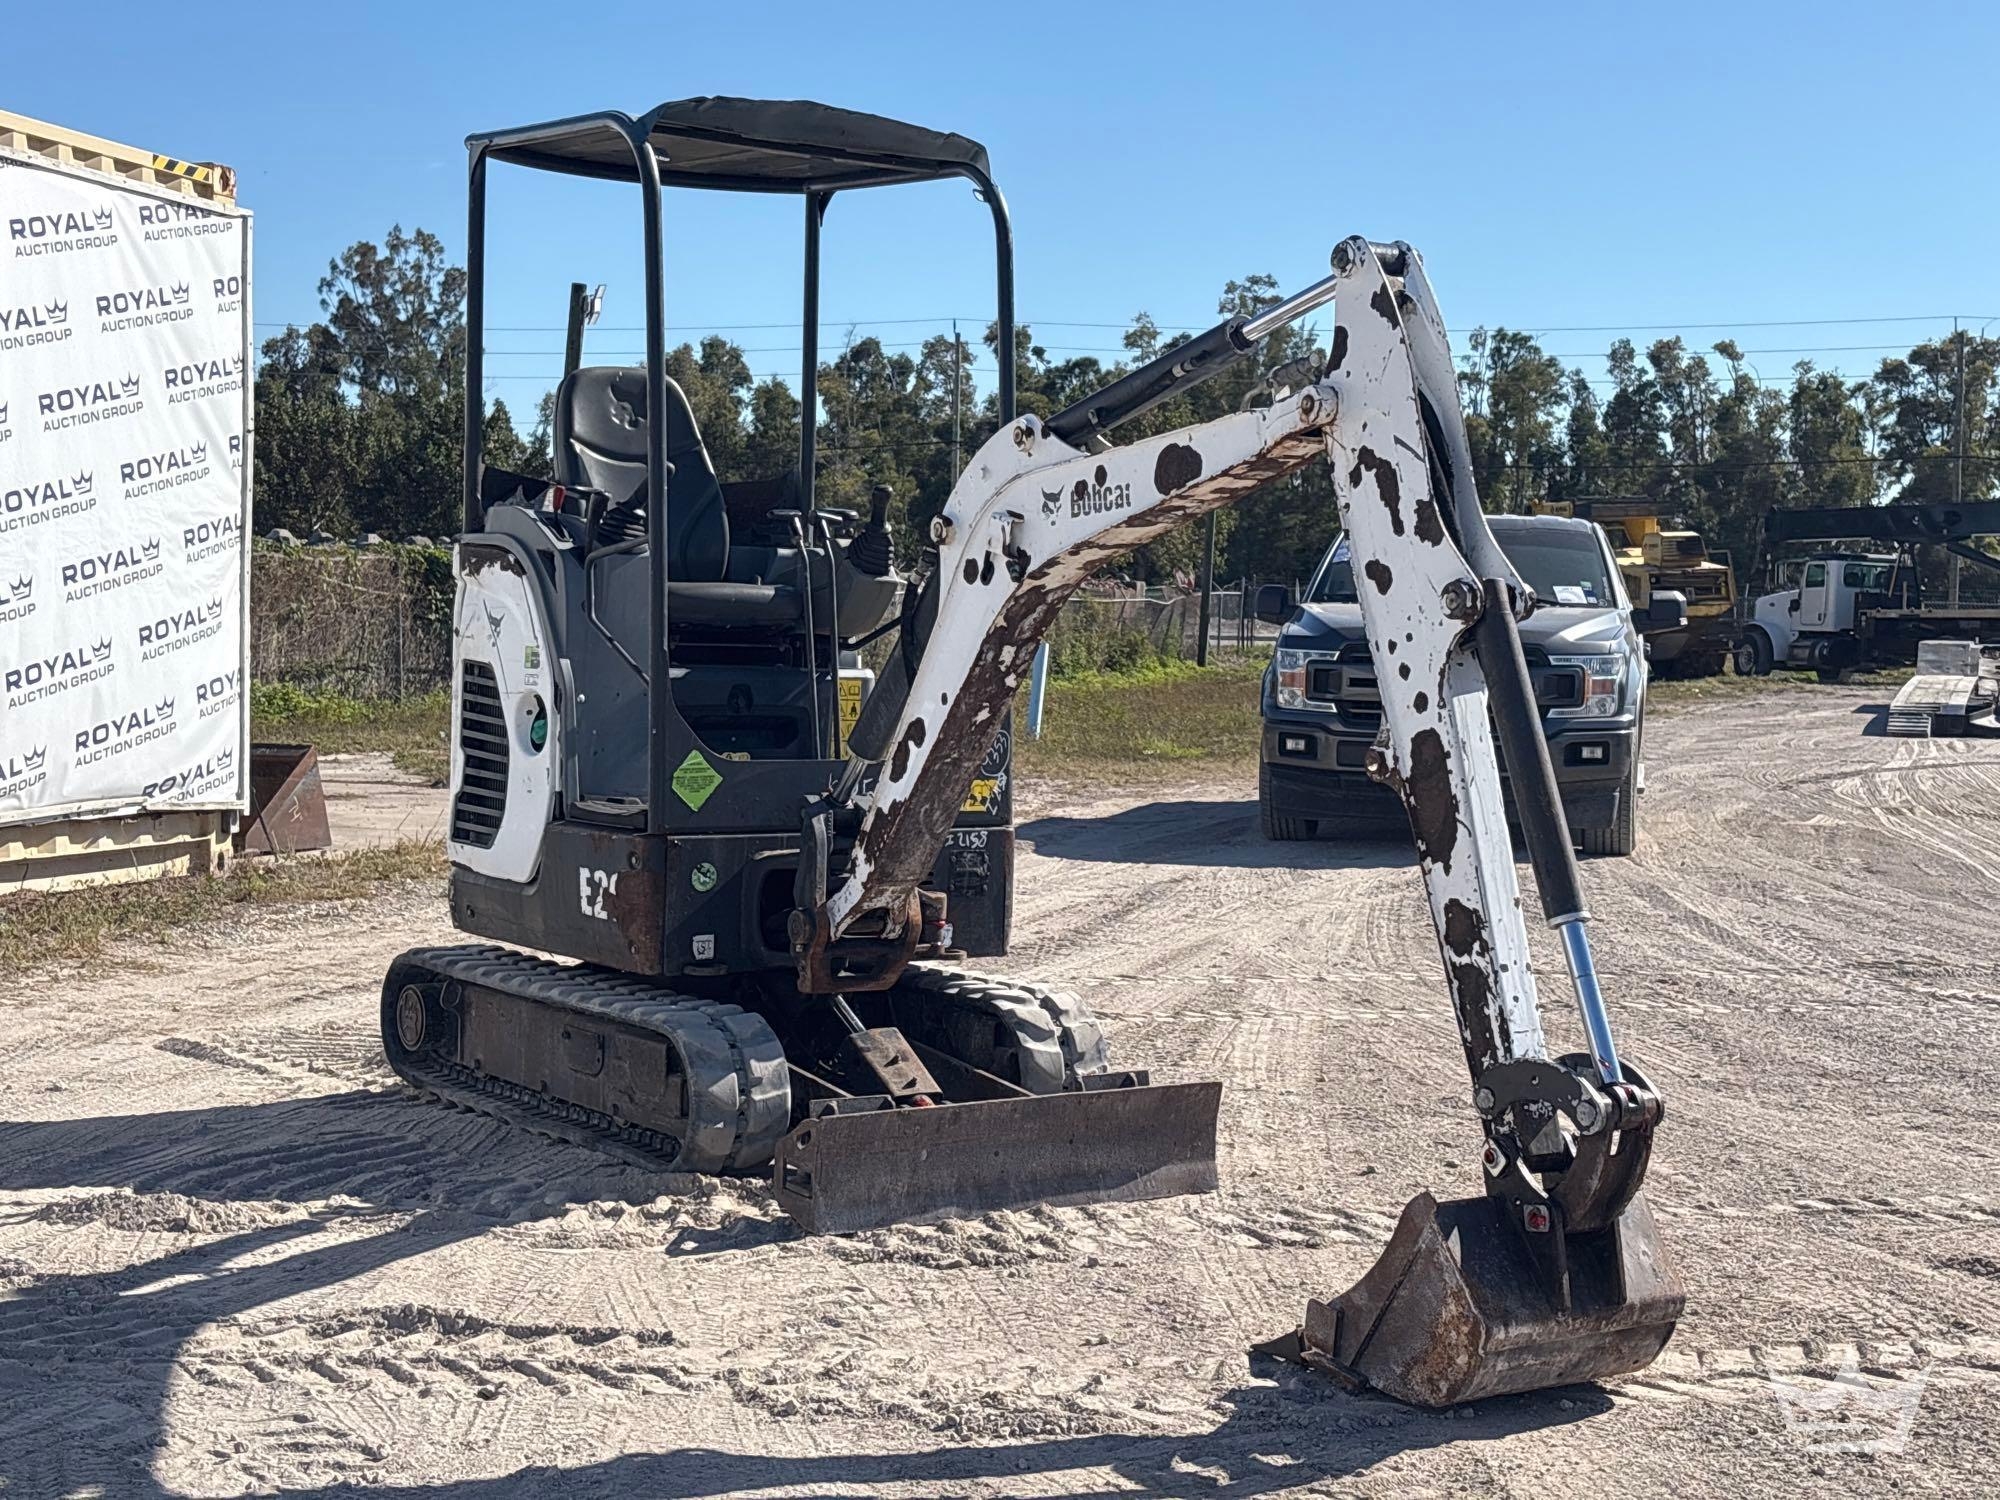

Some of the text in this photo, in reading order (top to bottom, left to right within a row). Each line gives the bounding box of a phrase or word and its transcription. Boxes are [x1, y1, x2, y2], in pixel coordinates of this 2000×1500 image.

[9, 211, 95, 240] ROYAL
[144, 222, 233, 242] AUCTION GROUP
[15, 234, 118, 258] AUCTION GROUP
[96, 287, 172, 316] ROYAL
[26, 328, 72, 346] GROUP
[101, 308, 193, 334] AUCTION GROUP
[164, 358, 233, 389] ROYAL
[38, 381, 121, 416] ROYAL
[168, 385, 215, 406] AUCTION
[43, 401, 144, 432] AUCTION GROUP
[120, 448, 192, 483] ROYAL
[0, 479, 72, 515] OYAL
[124, 467, 210, 500] AUCTION GROUP
[52, 498, 97, 519] GROUP
[183, 513, 241, 549] ROYAL
[61, 546, 142, 586] ROYAL
[187, 541, 227, 566] AUCTION
[65, 563, 164, 603] AUCTION GROUP
[138, 605, 207, 647] ROYAL
[141, 621, 223, 663] AUCTION GROUP
[5, 647, 92, 693] ROYAL
[8, 663, 115, 711] AUCTION GROUP
[74, 721, 177, 769] AUCTION GROUP
[75, 707, 156, 753] ROYAL
[141, 758, 216, 799] ROYAL
[197, 770, 235, 796] GROUP
